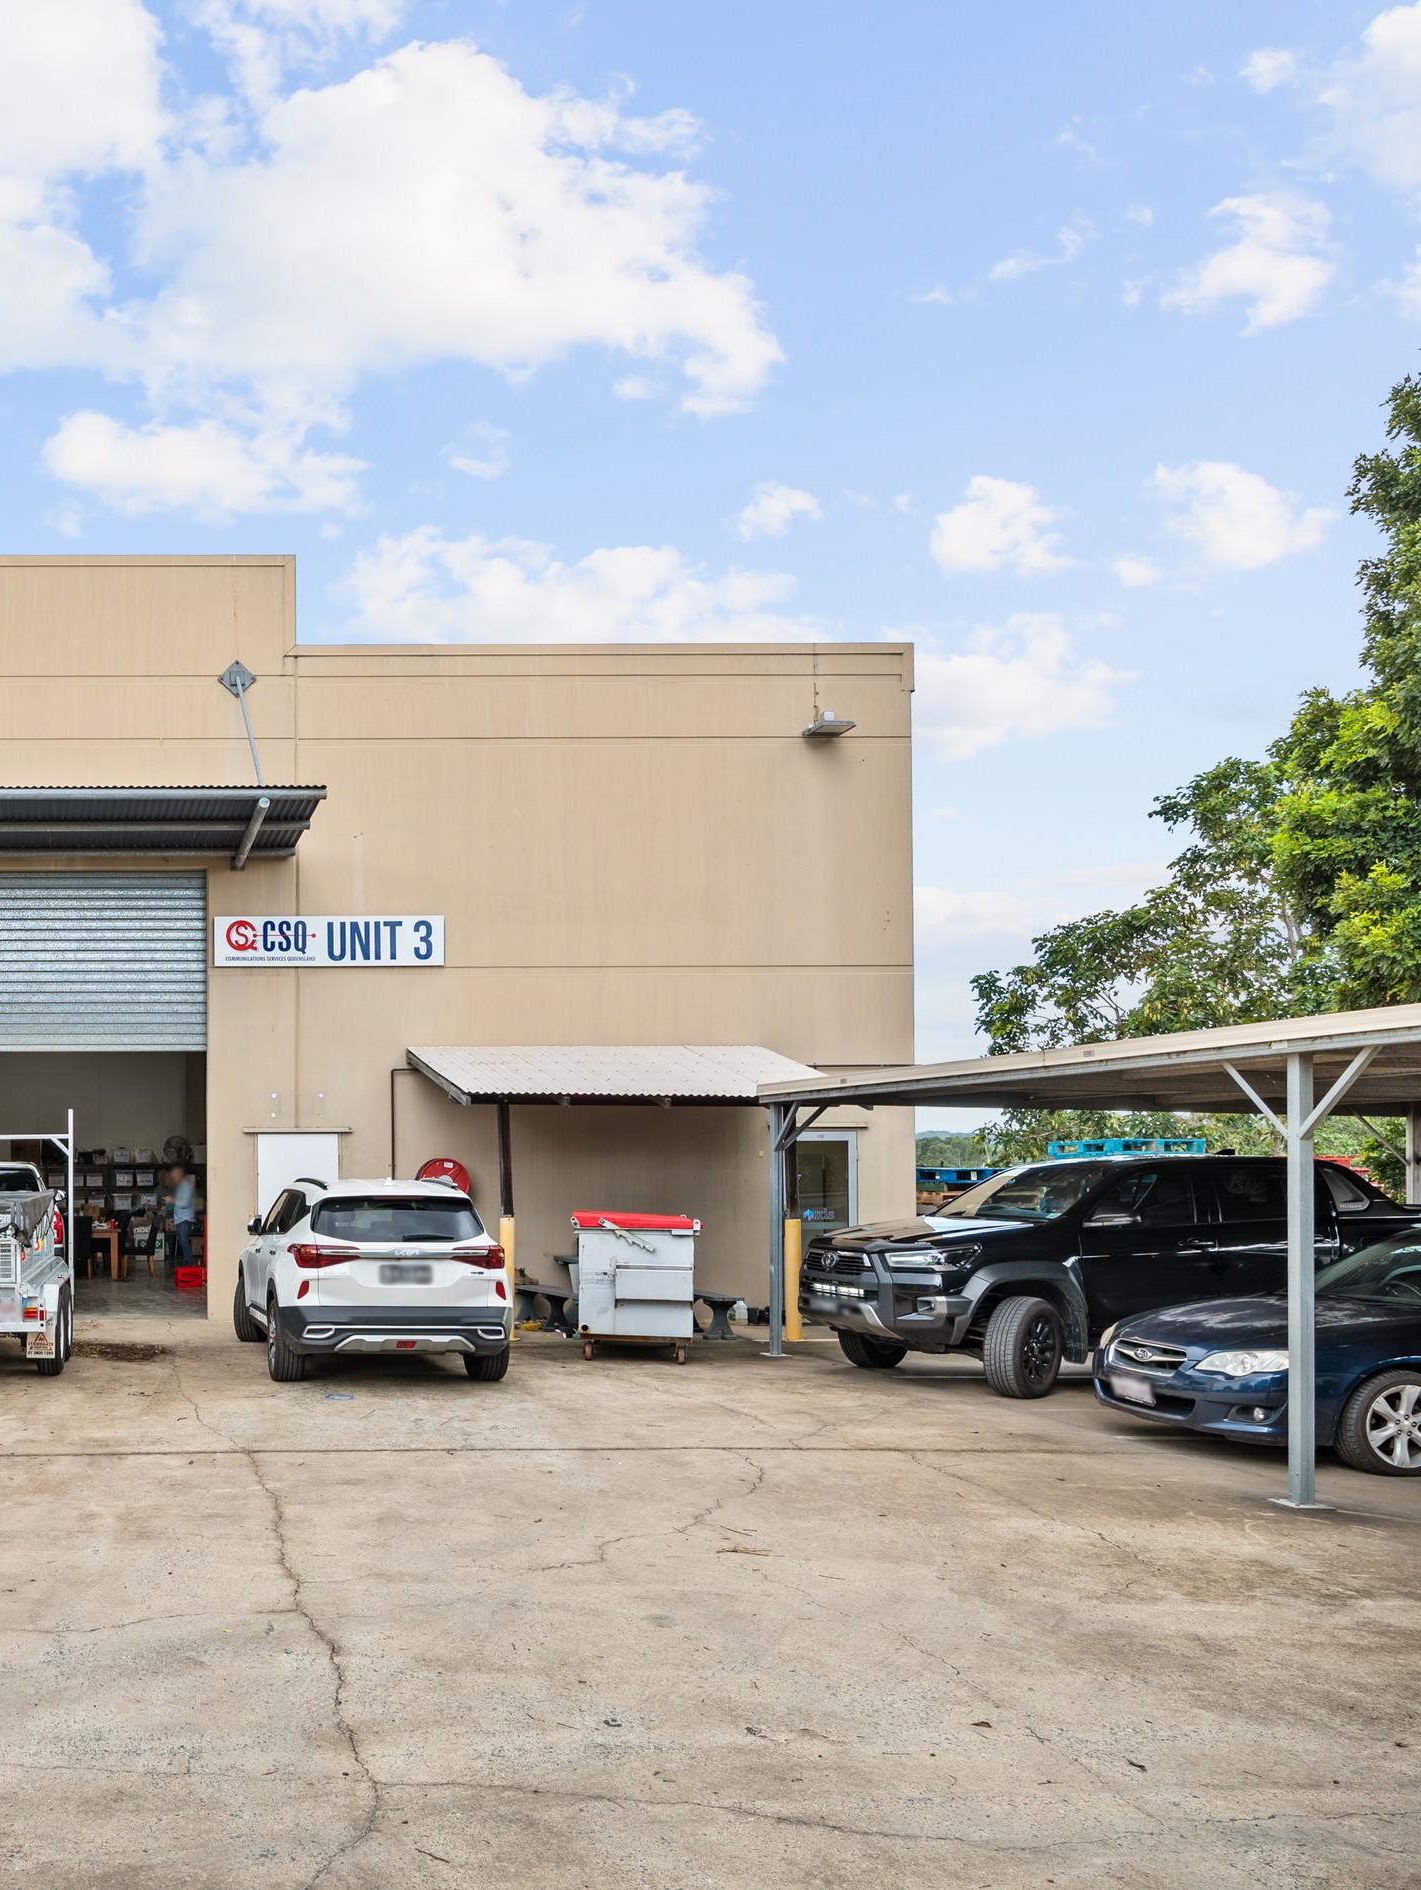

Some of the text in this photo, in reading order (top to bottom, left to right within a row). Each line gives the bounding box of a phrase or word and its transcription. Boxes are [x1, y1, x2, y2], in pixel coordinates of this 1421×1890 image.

[262, 920, 308, 955] CSQ
[327, 920, 433, 962] UNIT 3
